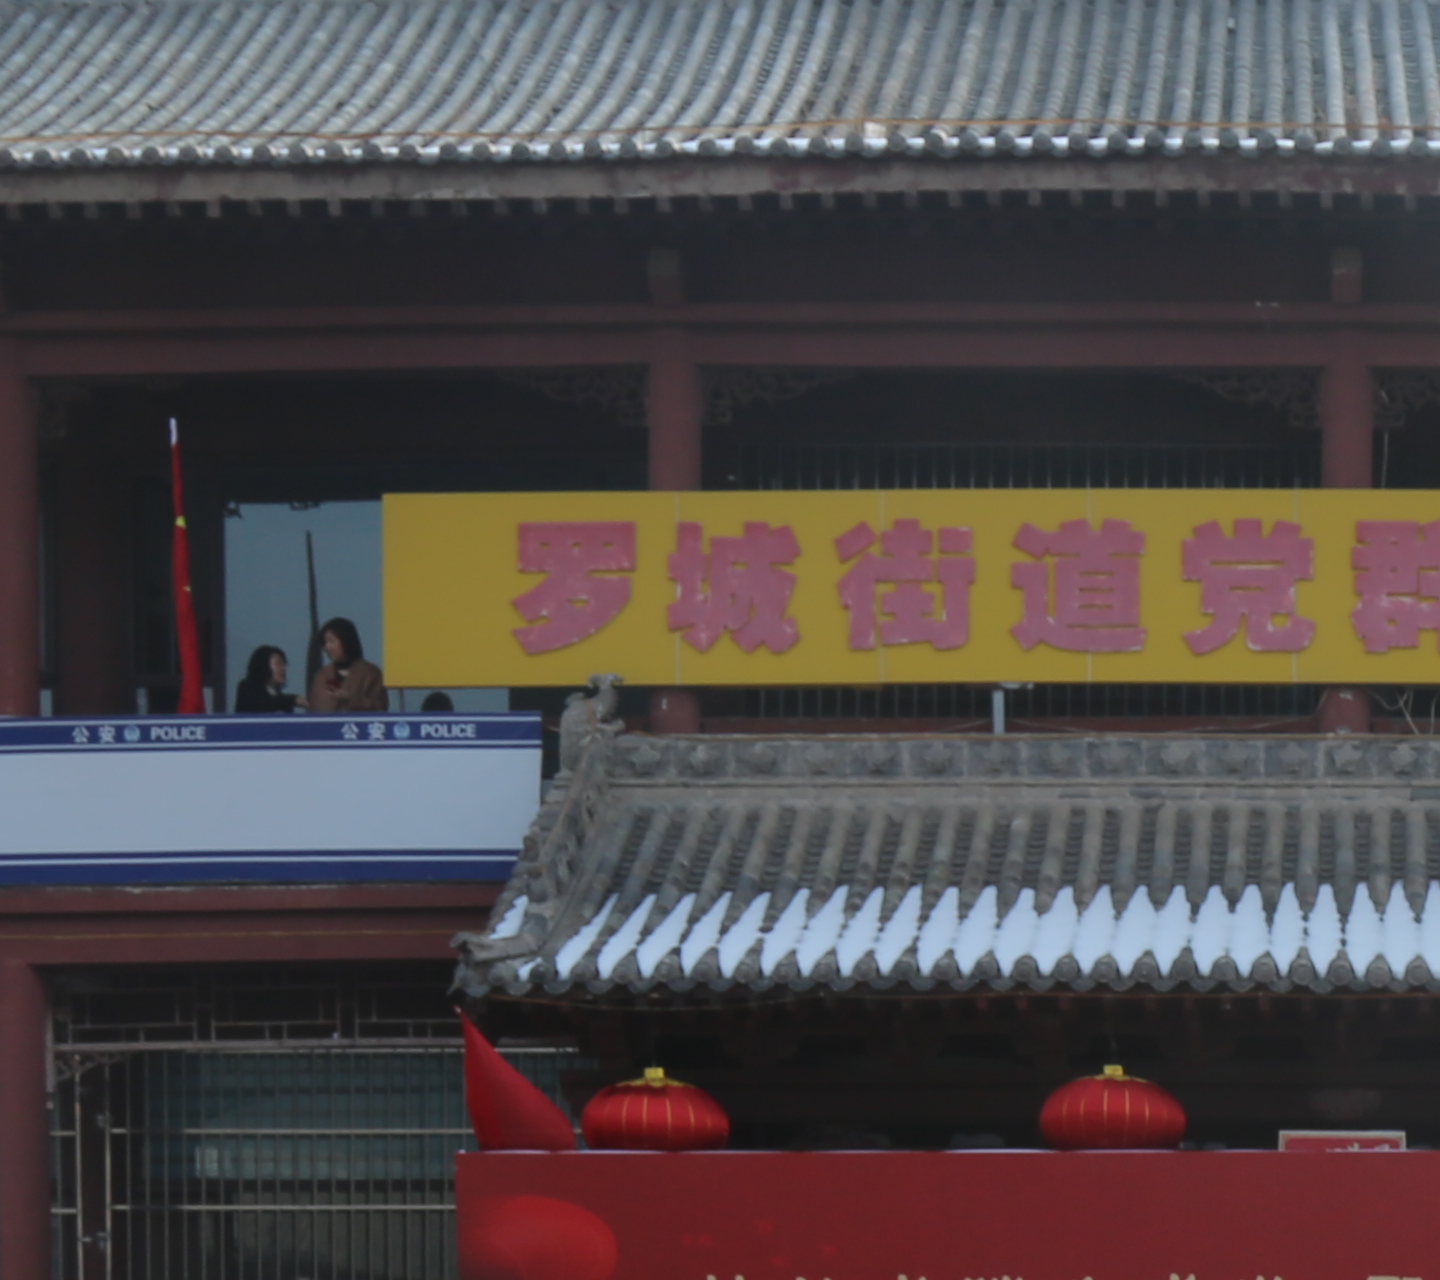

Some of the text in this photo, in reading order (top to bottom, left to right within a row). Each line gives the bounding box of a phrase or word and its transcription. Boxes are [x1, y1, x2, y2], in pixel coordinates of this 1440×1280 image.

[71, 725, 207, 743] 公安 POLICE
[341, 721, 477, 740] 公安 POLICE
